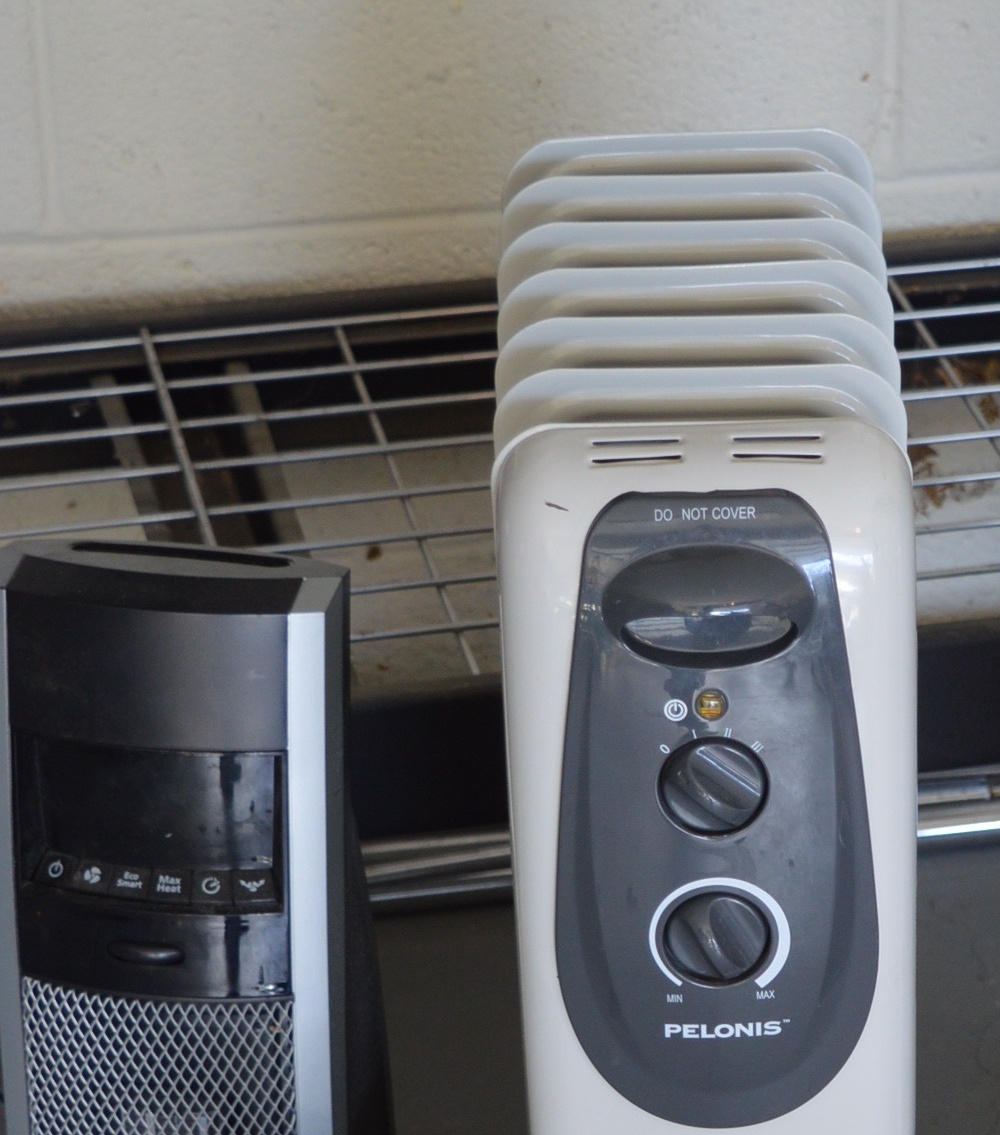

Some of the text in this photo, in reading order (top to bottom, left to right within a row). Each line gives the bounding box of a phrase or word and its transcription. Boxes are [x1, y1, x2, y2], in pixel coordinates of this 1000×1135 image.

[654, 506, 756, 522] DO NOT COVER
[124, 871, 140, 881] Eco
[159, 874, 182, 885] Max
[117, 878, 143, 890] Smart
[157, 883, 182, 894] Heat
[666, 994, 683, 1003] MIN
[756, 990, 776, 1000] MAX
[664, 1020, 782, 1039] PELONIS
